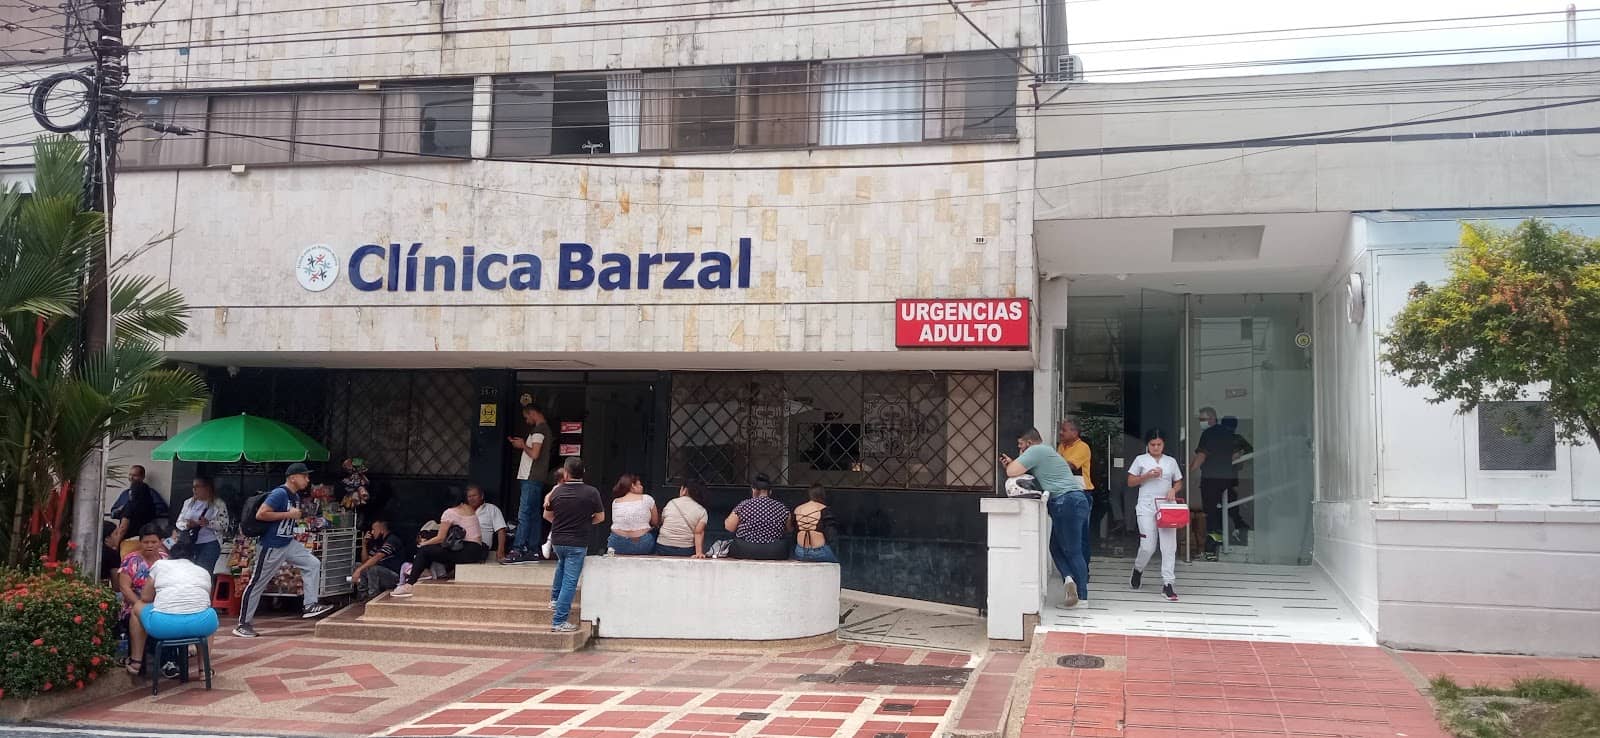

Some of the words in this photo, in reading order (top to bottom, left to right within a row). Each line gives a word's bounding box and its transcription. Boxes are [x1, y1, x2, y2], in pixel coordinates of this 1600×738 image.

[348, 242, 542, 292] Clínica
[558, 238, 751, 290] Barzal
[901, 301, 1023, 321] URGENCIAS
[919, 323, 1003, 342] ADULTO
